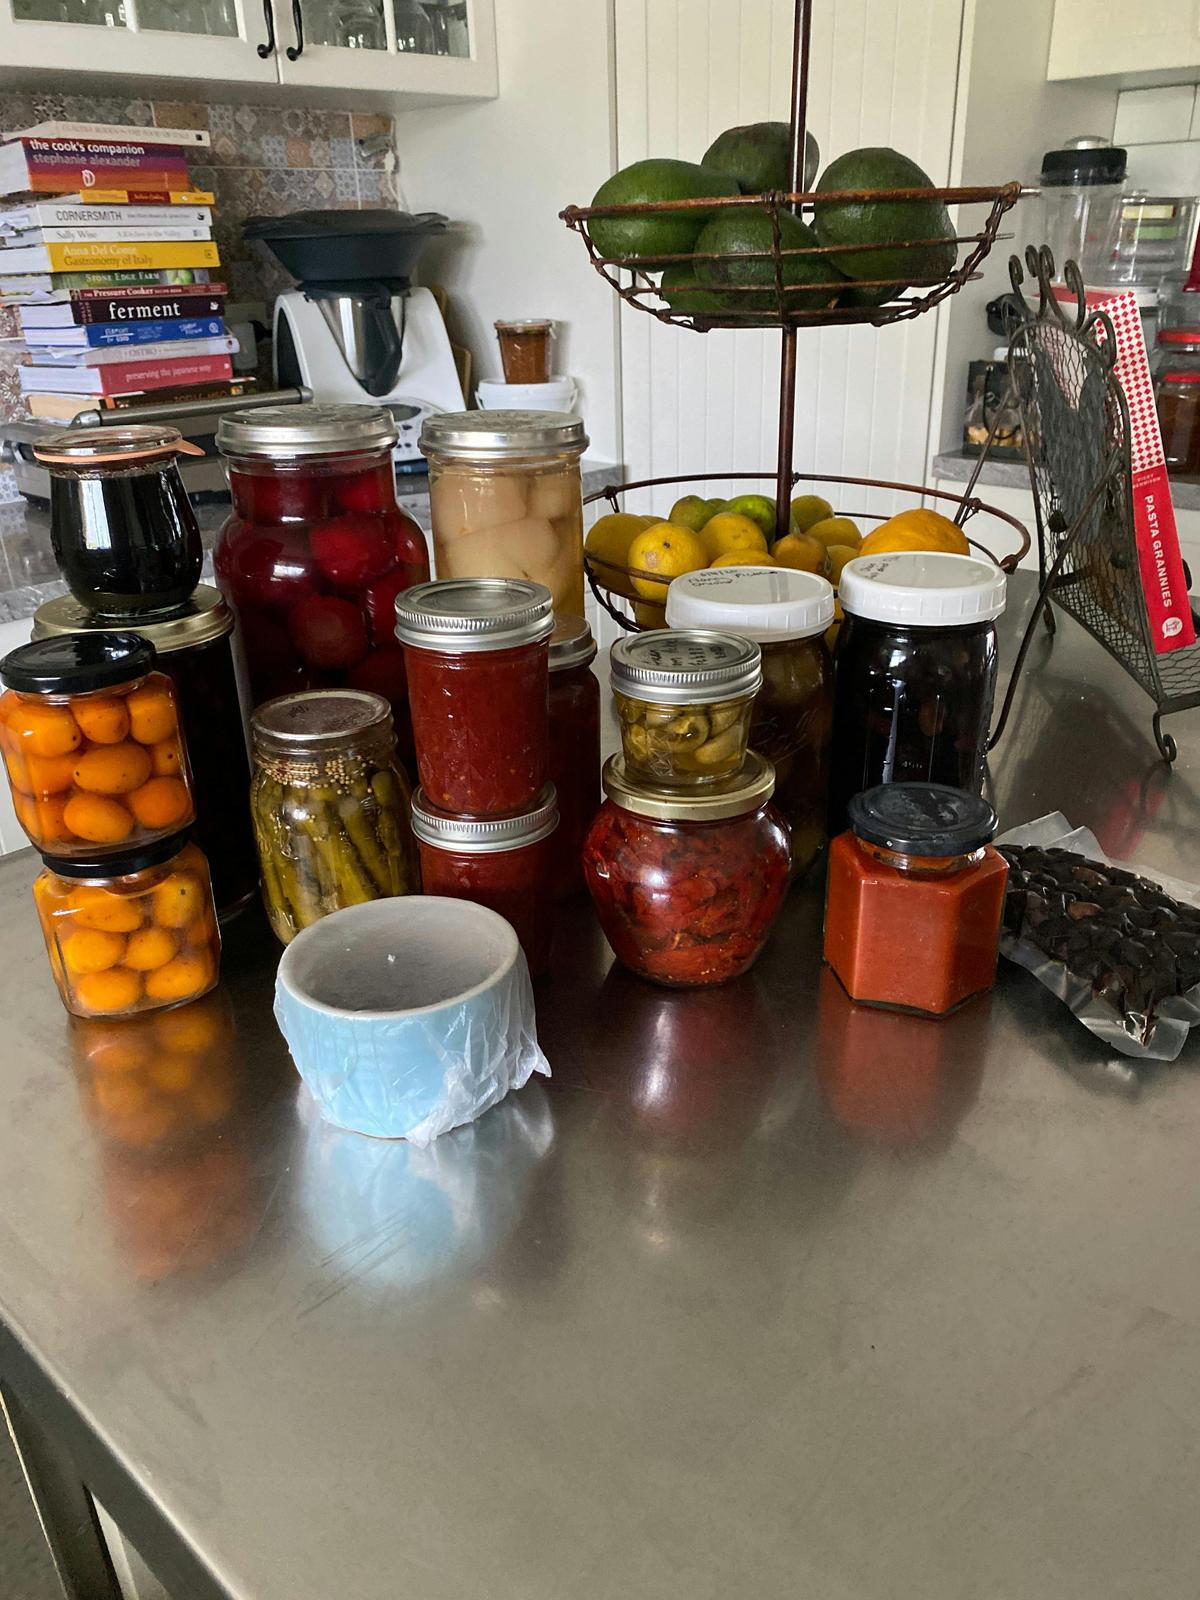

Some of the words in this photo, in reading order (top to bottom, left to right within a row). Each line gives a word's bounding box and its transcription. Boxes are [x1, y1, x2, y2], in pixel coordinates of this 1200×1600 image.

[30, 139, 49, 151] the
[52, 140, 85, 152] cook's
[88, 143, 145, 156] companion
[33, 153, 87, 166] stephanie
[90, 155, 141, 167] alexander
[56, 210, 122, 221] CORNERSMITH
[64, 255, 120, 268] Gastronomy
[122, 254, 131, 265] of
[132, 254, 153, 266] Italy
[114, 272, 137, 281] EDGE
[139, 272, 159, 280] FARM
[93, 289, 126, 297] Pressure
[127, 287, 154, 296] Cooker
[109, 301, 181, 320] ferment
[126, 370, 160, 383] preserving
[160, 367, 171, 377] the
[172, 366, 198, 377] japanese
[1145, 495, 1160, 537] PASTA
[1152, 540, 1172, 607] GRANNIES
